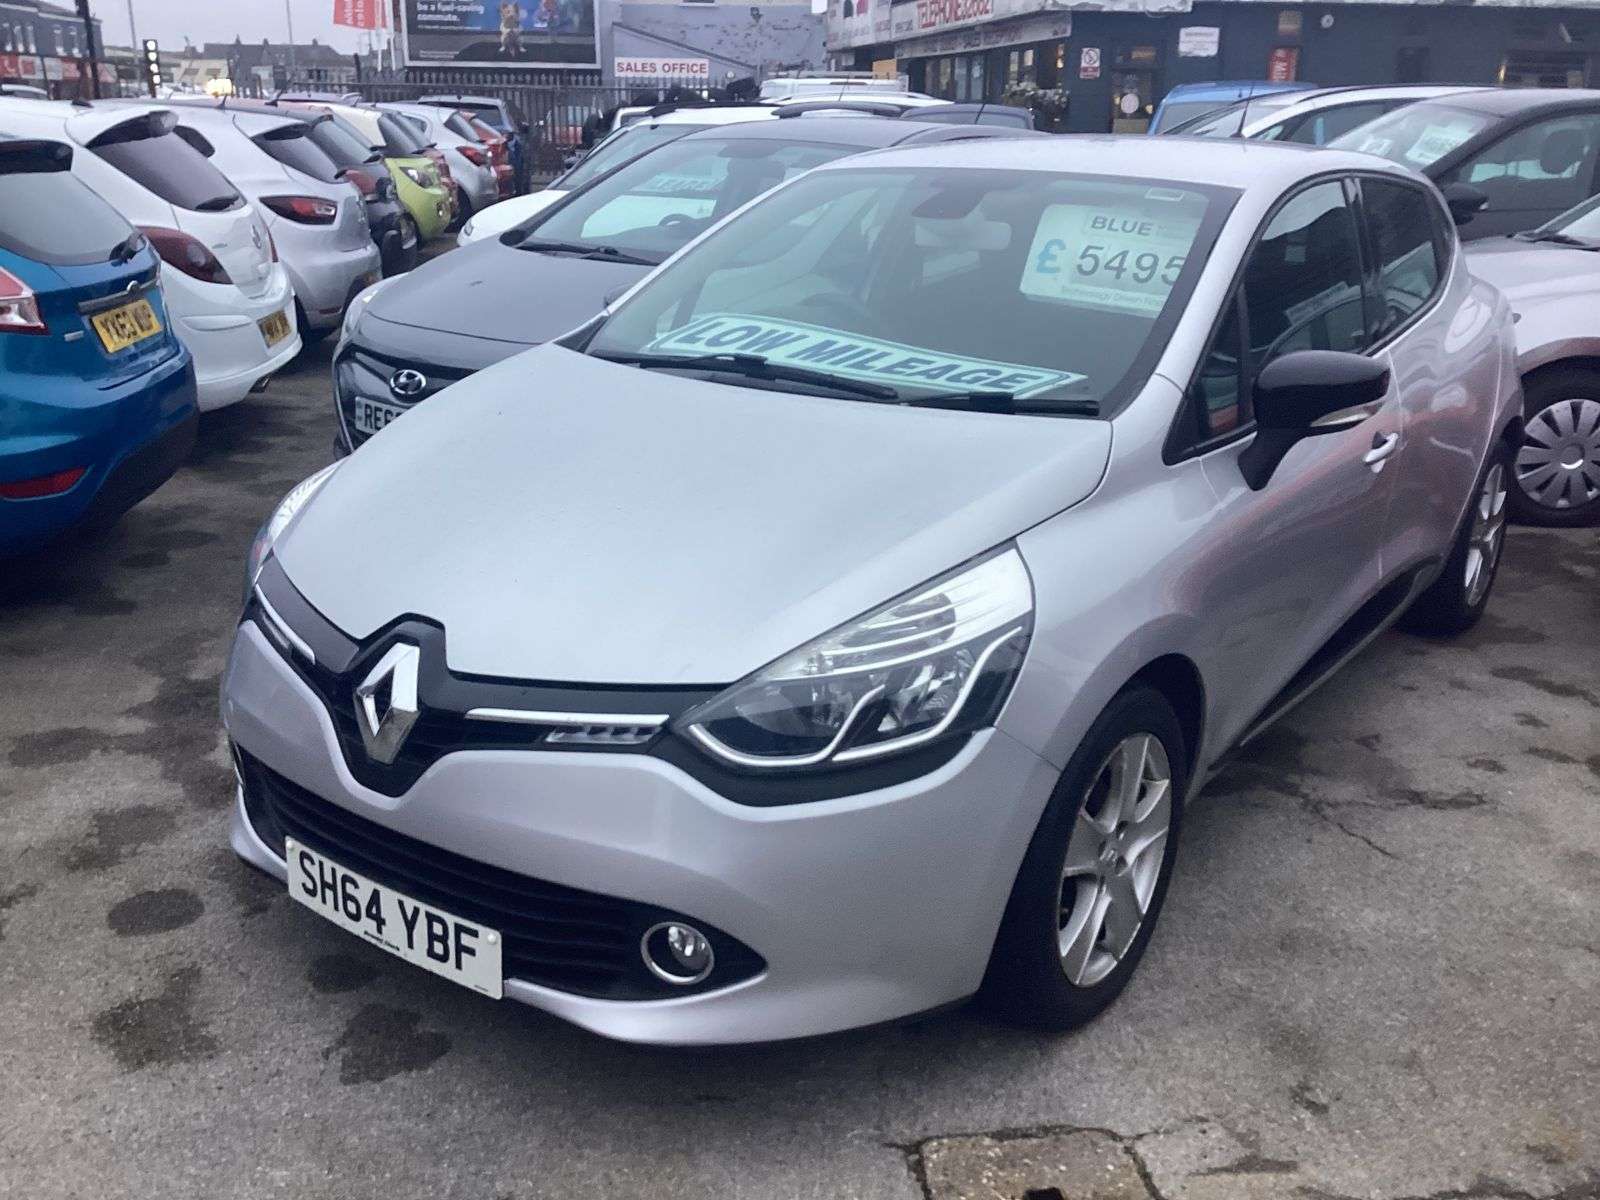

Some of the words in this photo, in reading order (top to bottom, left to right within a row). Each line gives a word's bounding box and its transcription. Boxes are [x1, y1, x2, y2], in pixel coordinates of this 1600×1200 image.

[616, 62, 657, 73] SALES
[662, 62, 707, 74] OFFICE
[1090, 215, 1154, 236] BLUE
[1036, 238, 1066, 274] £
[1076, 244, 1187, 285] 5495
[676, 320, 805, 354] LOW
[798, 338, 1045, 391] MILEAGE
[299, 850, 386, 935] SH64
[397, 898, 479, 971] YBF
